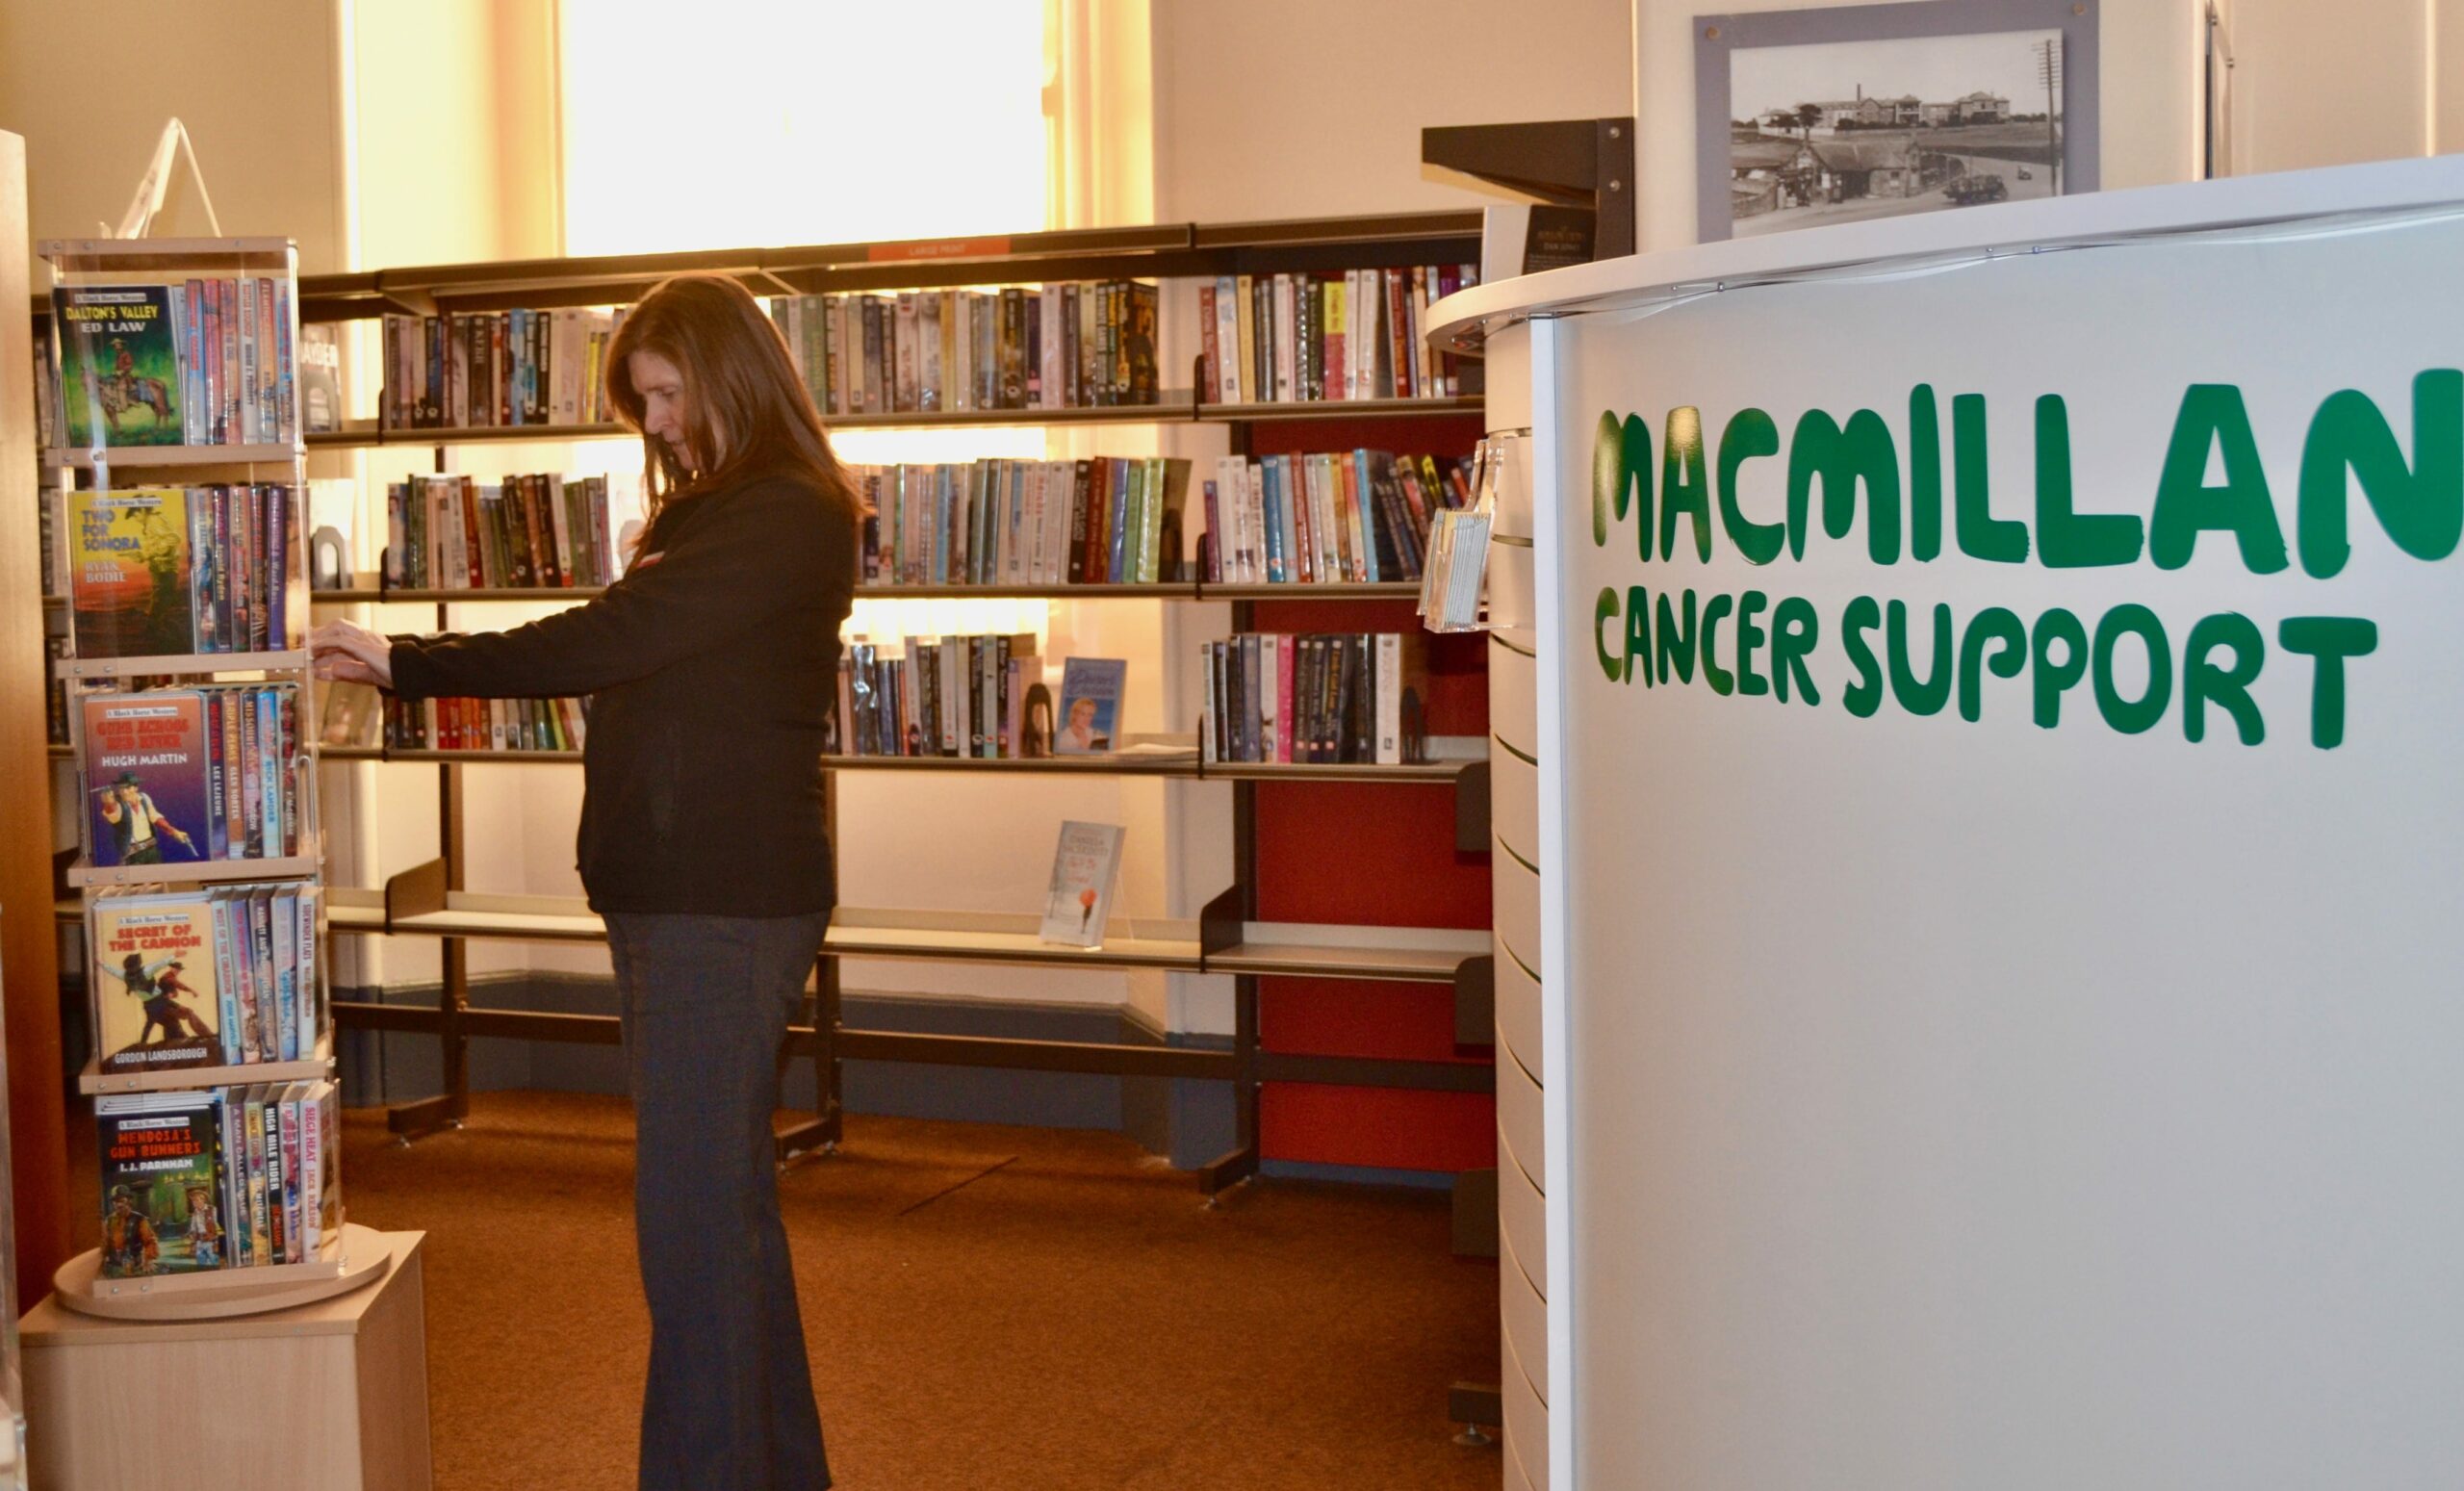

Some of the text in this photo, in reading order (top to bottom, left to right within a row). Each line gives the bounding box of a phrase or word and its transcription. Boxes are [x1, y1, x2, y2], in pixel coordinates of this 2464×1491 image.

[65, 304, 158, 320] DALTON'S VALLEY
[81, 321, 146, 333] ED LAW
[1592, 367, 2464, 579] MACMILLAN
[82, 509, 116, 523] TWO
[82, 523, 109, 536] FOR
[84, 537, 141, 552] SONORA
[85, 571, 127, 583] BODIE
[1595, 584, 2378, 750] CANCER SUPPORT
[245, 700, 255, 746] MISSOURI
[102, 753, 188, 767] HUGH MARTIN
[267, 785, 275, 823] LANDER
[216, 908, 224, 927] WEST
[117, 924, 192, 938] SECRET OF
[218, 929, 226, 939] OF
[303, 904, 312, 960] SIDEWINDER FLATS
[109, 936, 201, 952] THE CANNON
[219, 941, 229, 955] THE
[115, 1047, 208, 1064] GORDON LANDSBOROUGH
[265, 1108, 277, 1132] HIGH
[117, 1129, 192, 1144] MENDOSA'S
[234, 1118, 243, 1144] MAN
[305, 1107, 317, 1163] SIEGE HEAT
[110, 1142, 201, 1159] GUN RUNNERS
[267, 1135, 278, 1158] MILE
[129, 1162, 139, 1171] J.
[140, 1159, 193, 1170] PARNHAM
[236, 1145, 245, 1187] CALLED
[269, 1161, 281, 1192] RIDER
[307, 1170, 317, 1229] JACK REASON
